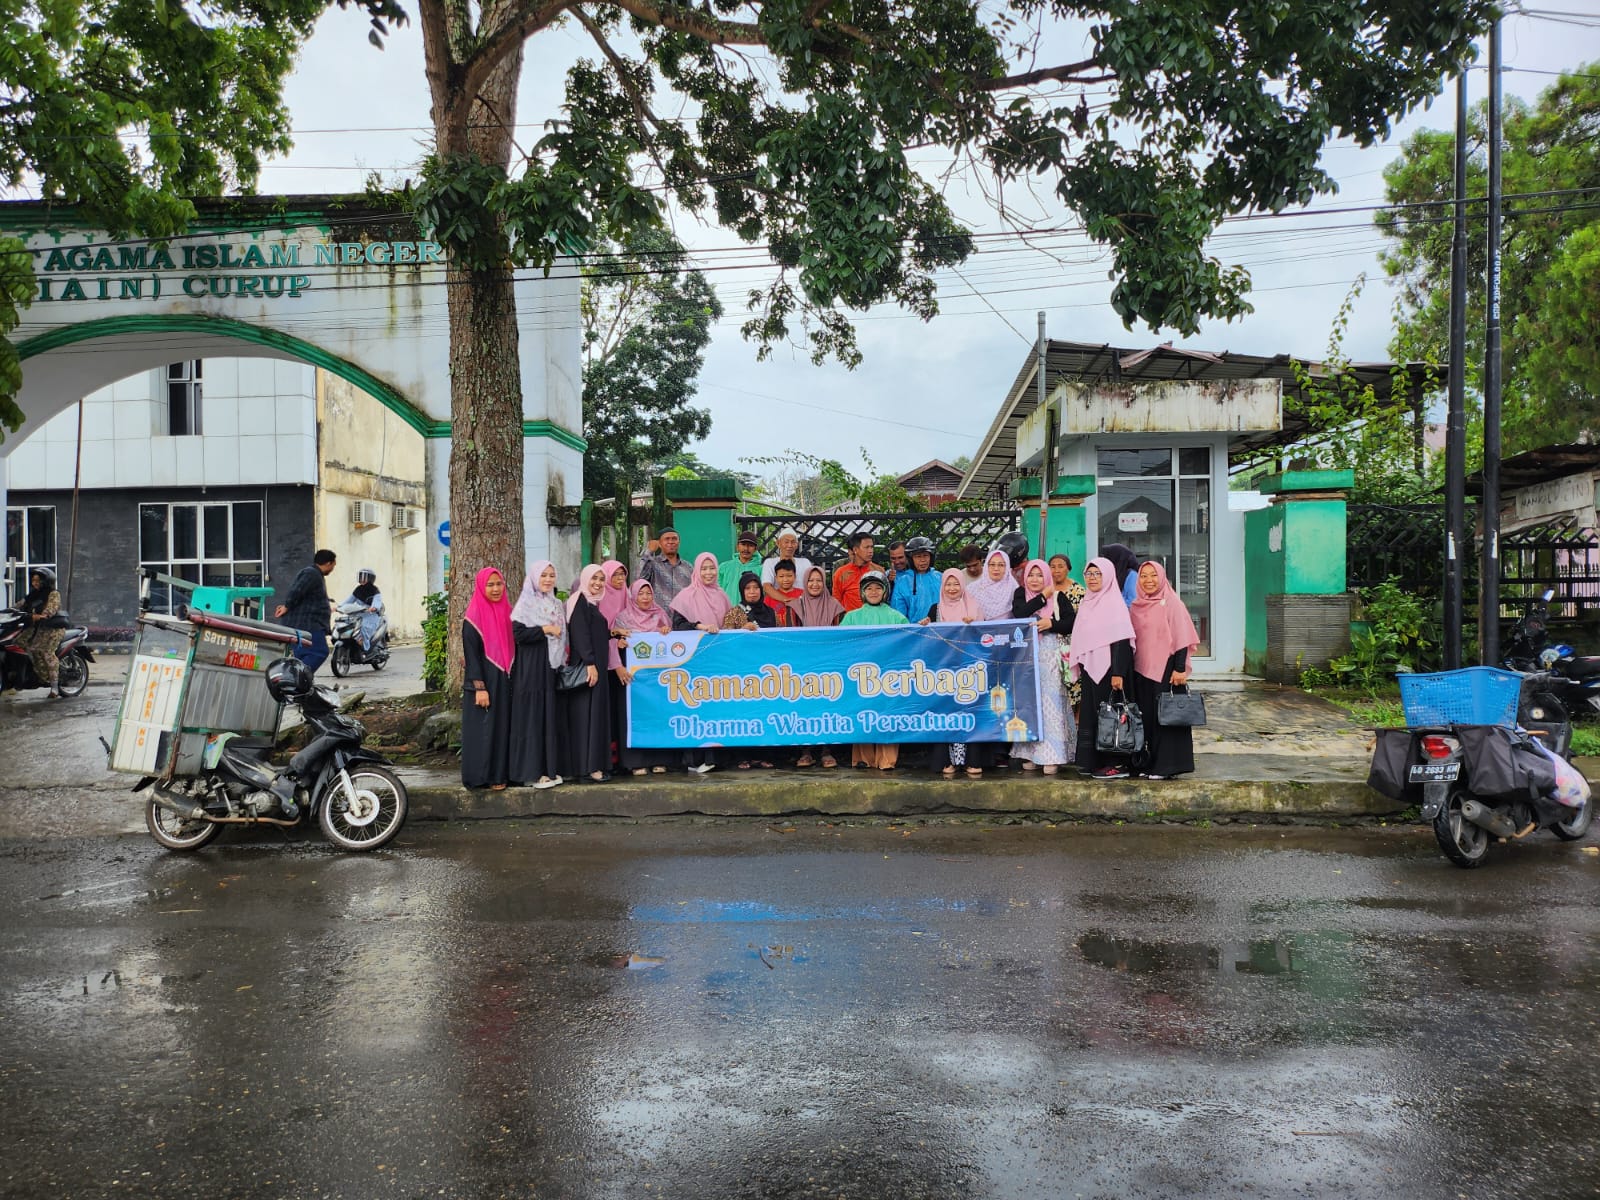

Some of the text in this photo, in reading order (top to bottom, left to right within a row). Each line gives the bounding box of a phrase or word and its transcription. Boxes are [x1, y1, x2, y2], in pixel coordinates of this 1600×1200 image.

[44, 246, 177, 271] AGAMA
[182, 243, 301, 269] ISLAM
[314, 241, 443, 265] NEGER
[38, 272, 311, 301] IAIN) CURUP
[141, 663, 183, 678] SATE
[658, 659, 988, 708] Ramadhan Berbagi
[669, 709, 976, 739] Dharma Wanita Persatuan
